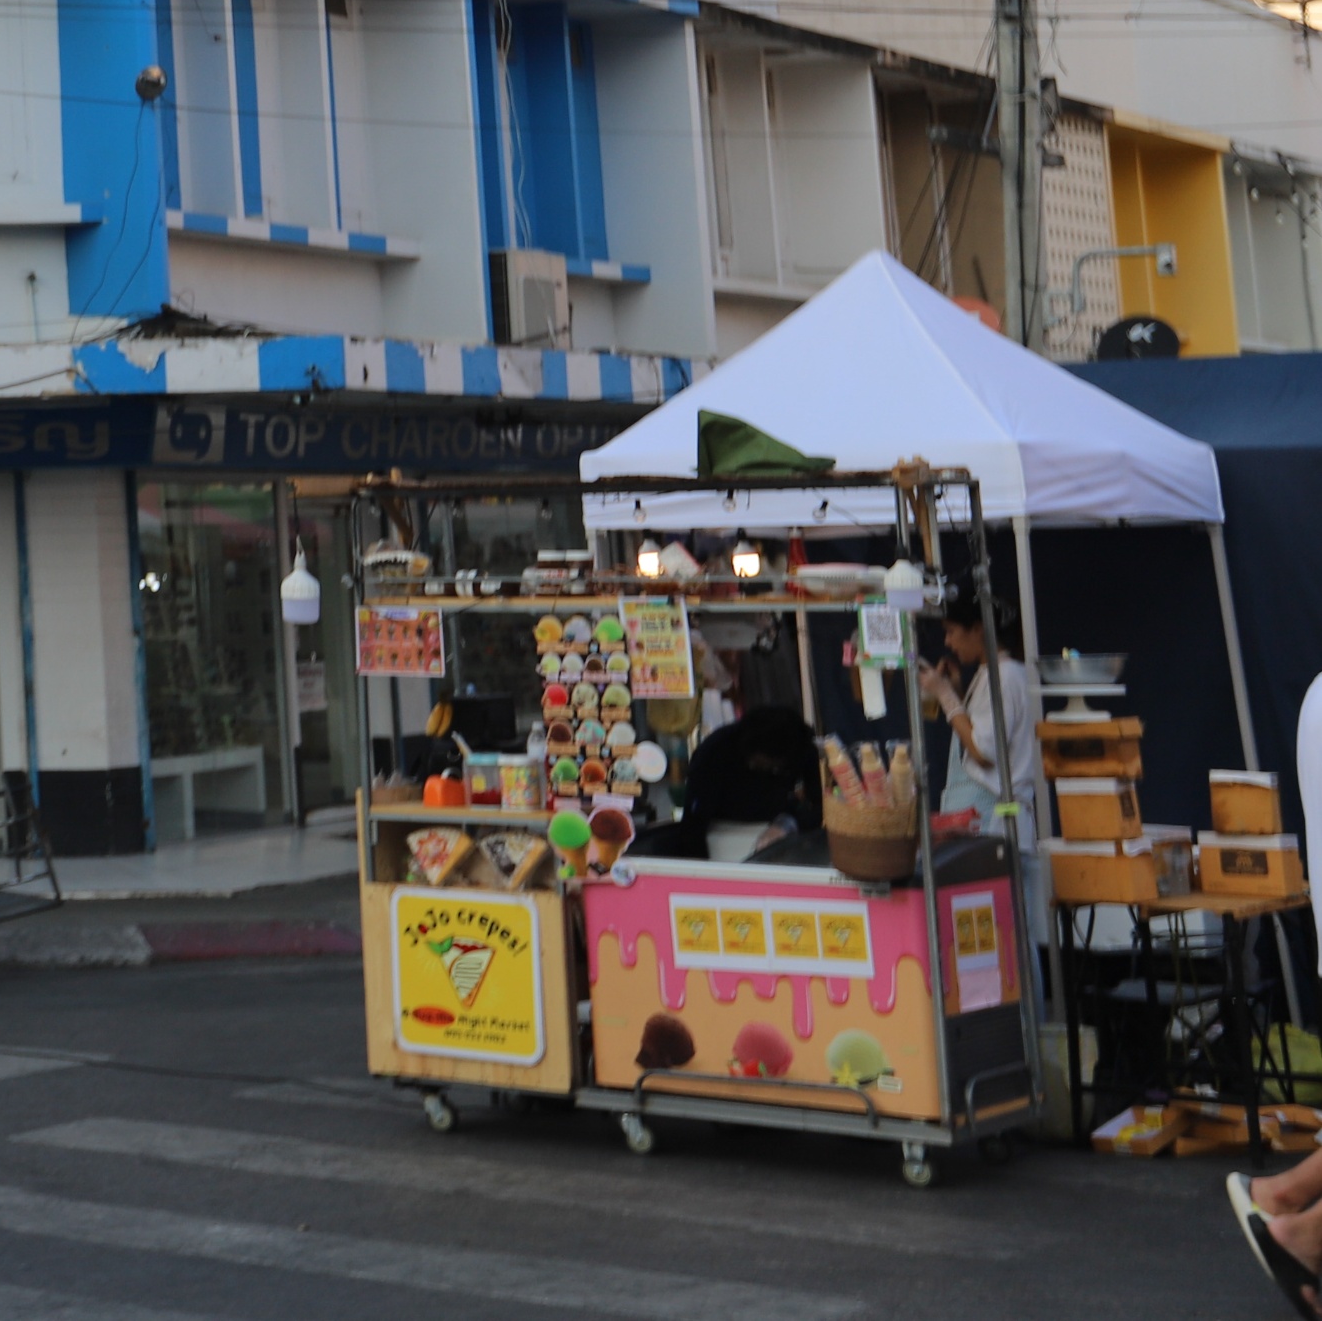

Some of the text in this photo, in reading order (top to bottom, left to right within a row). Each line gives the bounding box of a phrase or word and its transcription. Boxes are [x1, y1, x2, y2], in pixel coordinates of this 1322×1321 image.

[239, 411, 326, 459] TOP
[341, 416, 523, 461] CHAROEN
[403, 909, 450, 948] JoJo
